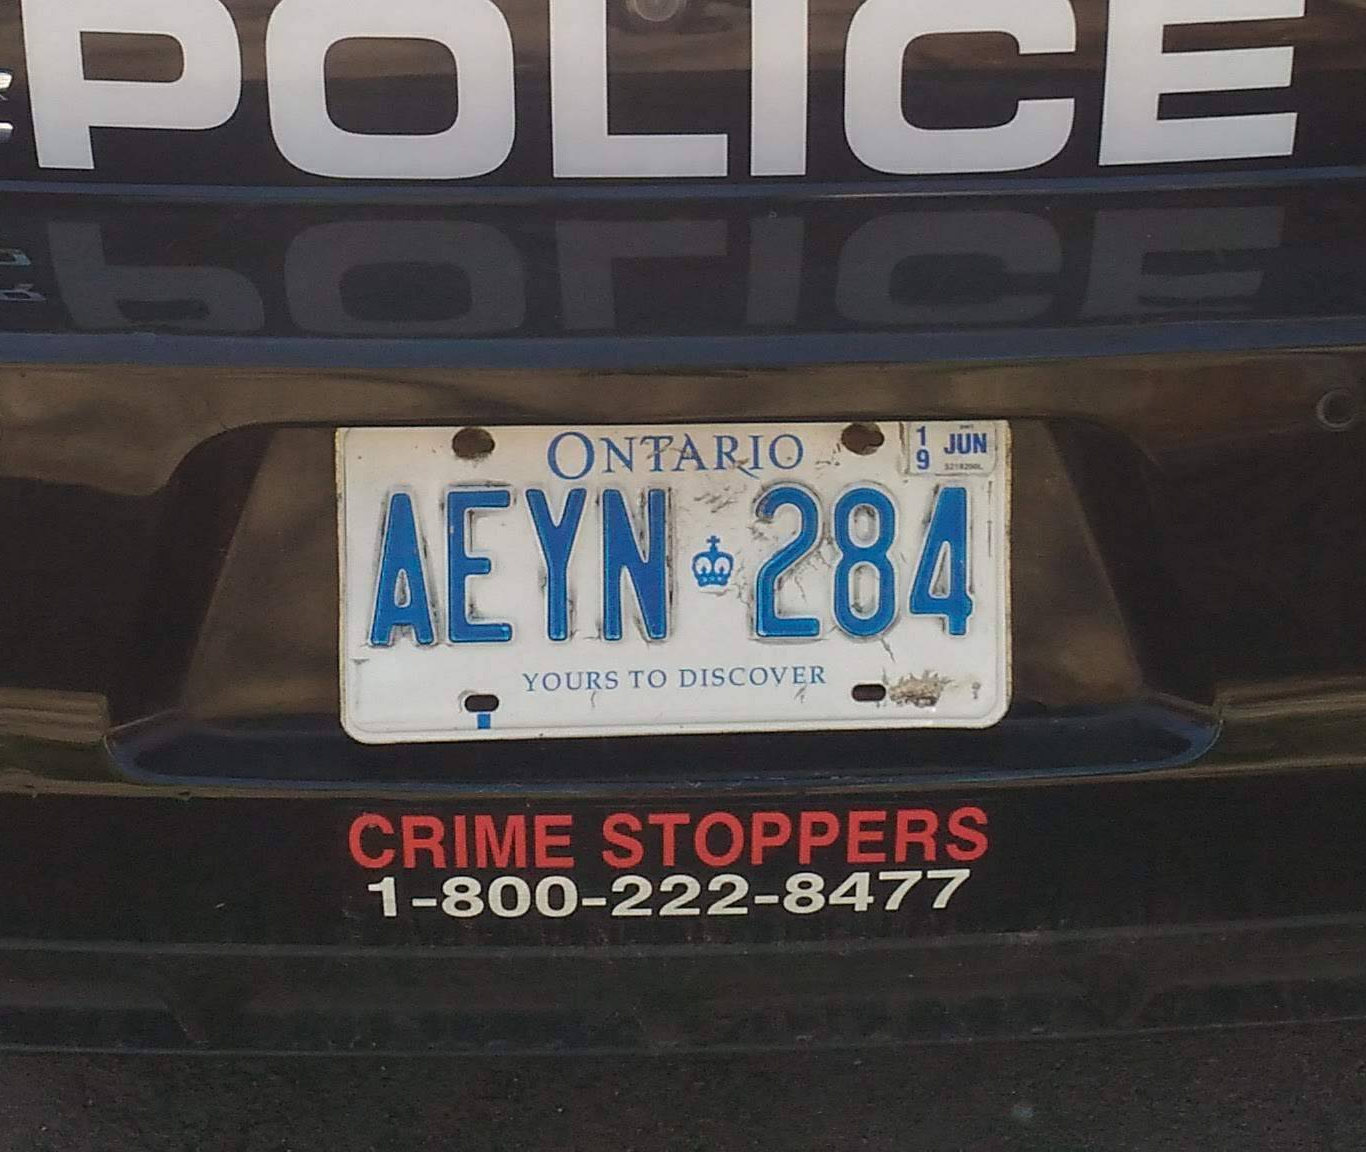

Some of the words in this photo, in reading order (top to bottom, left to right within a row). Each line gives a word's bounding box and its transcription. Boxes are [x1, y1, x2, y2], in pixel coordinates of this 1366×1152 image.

[547, 431, 803, 481] ONTARIO
[943, 432, 988, 455] JUN
[369, 488, 671, 646] AEYN
[753, 485, 973, 638] 284
[522, 671, 619, 692] YOURS
[629, 669, 667, 689] TO
[679, 665, 826, 688] DISCOVER
[348, 813, 574, 870] CRIME
[600, 807, 989, 868] STOPPERS
[367, 868, 971, 918] 1-800-222-8477
